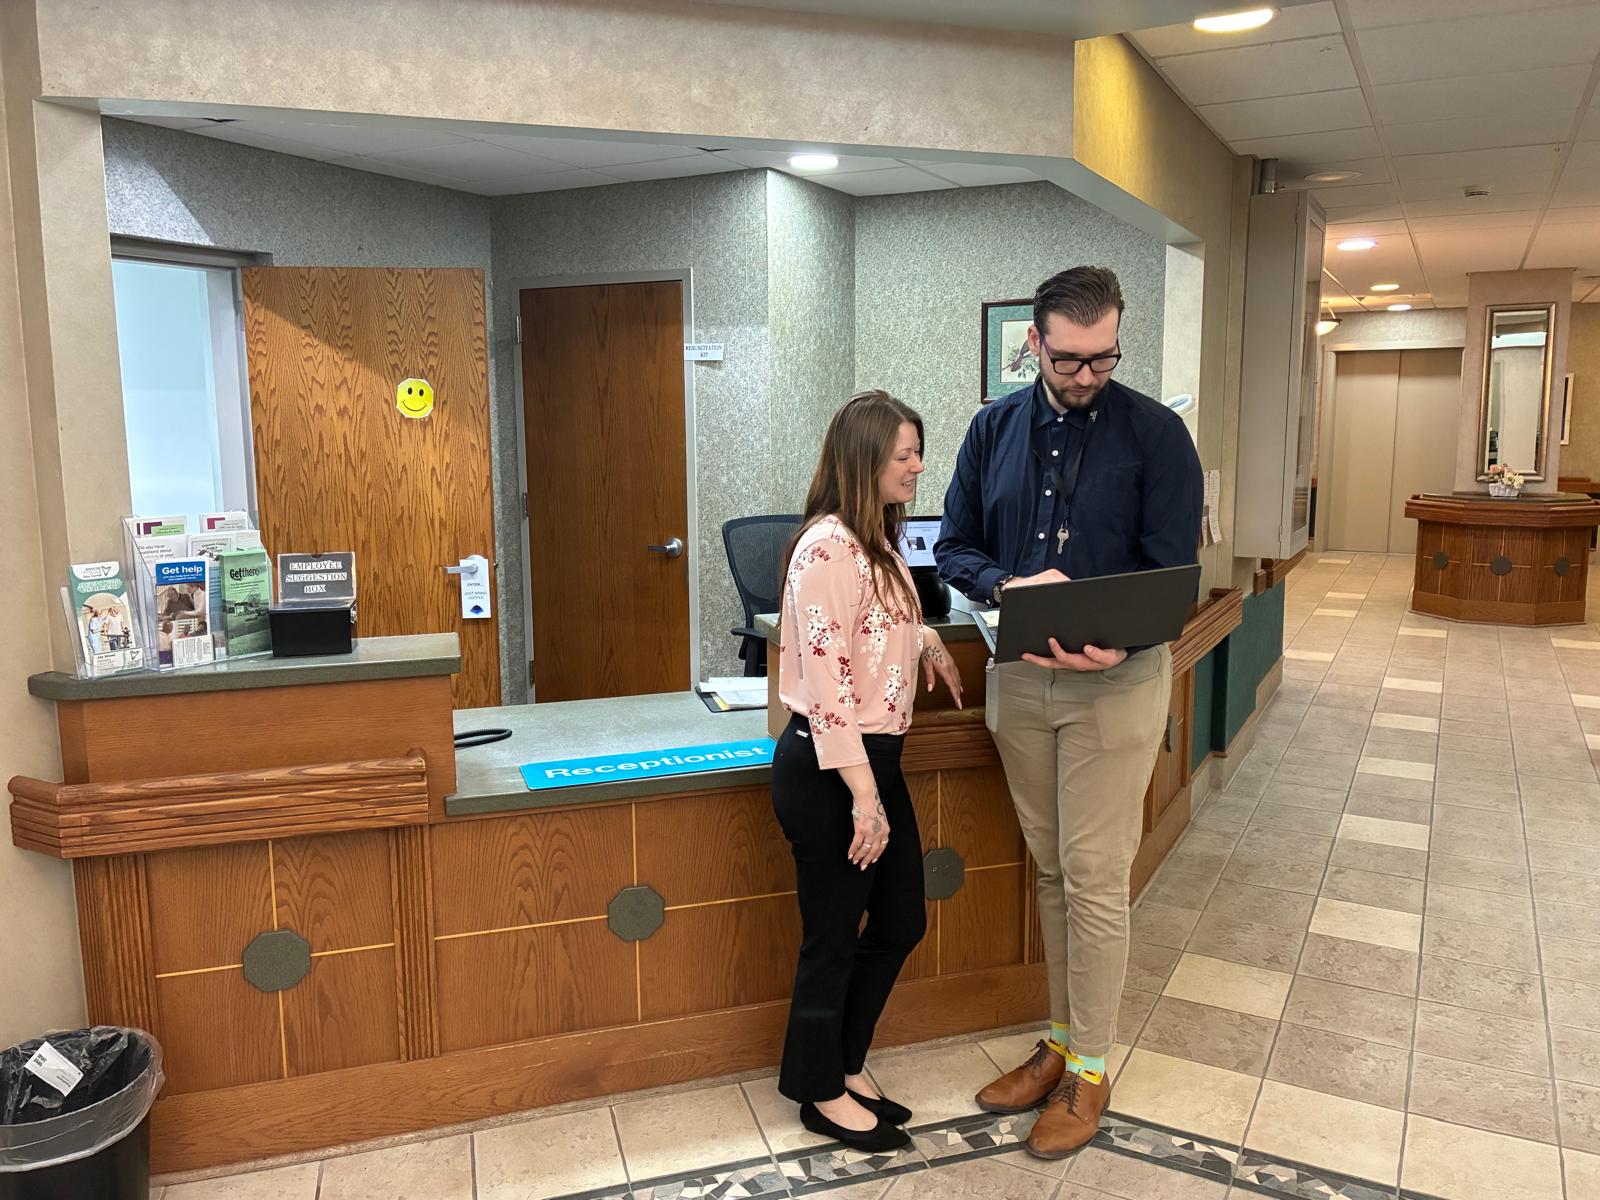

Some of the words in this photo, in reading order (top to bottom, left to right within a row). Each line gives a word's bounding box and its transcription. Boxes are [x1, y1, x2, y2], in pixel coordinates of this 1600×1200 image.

[161, 566, 180, 575] Get
[181, 565, 203, 574] help
[289, 561, 342, 570] EMPLOYEE
[285, 572, 347, 582] SUGGESTION
[304, 584, 326, 593] BOX
[544, 747, 769, 779] Receptionist
